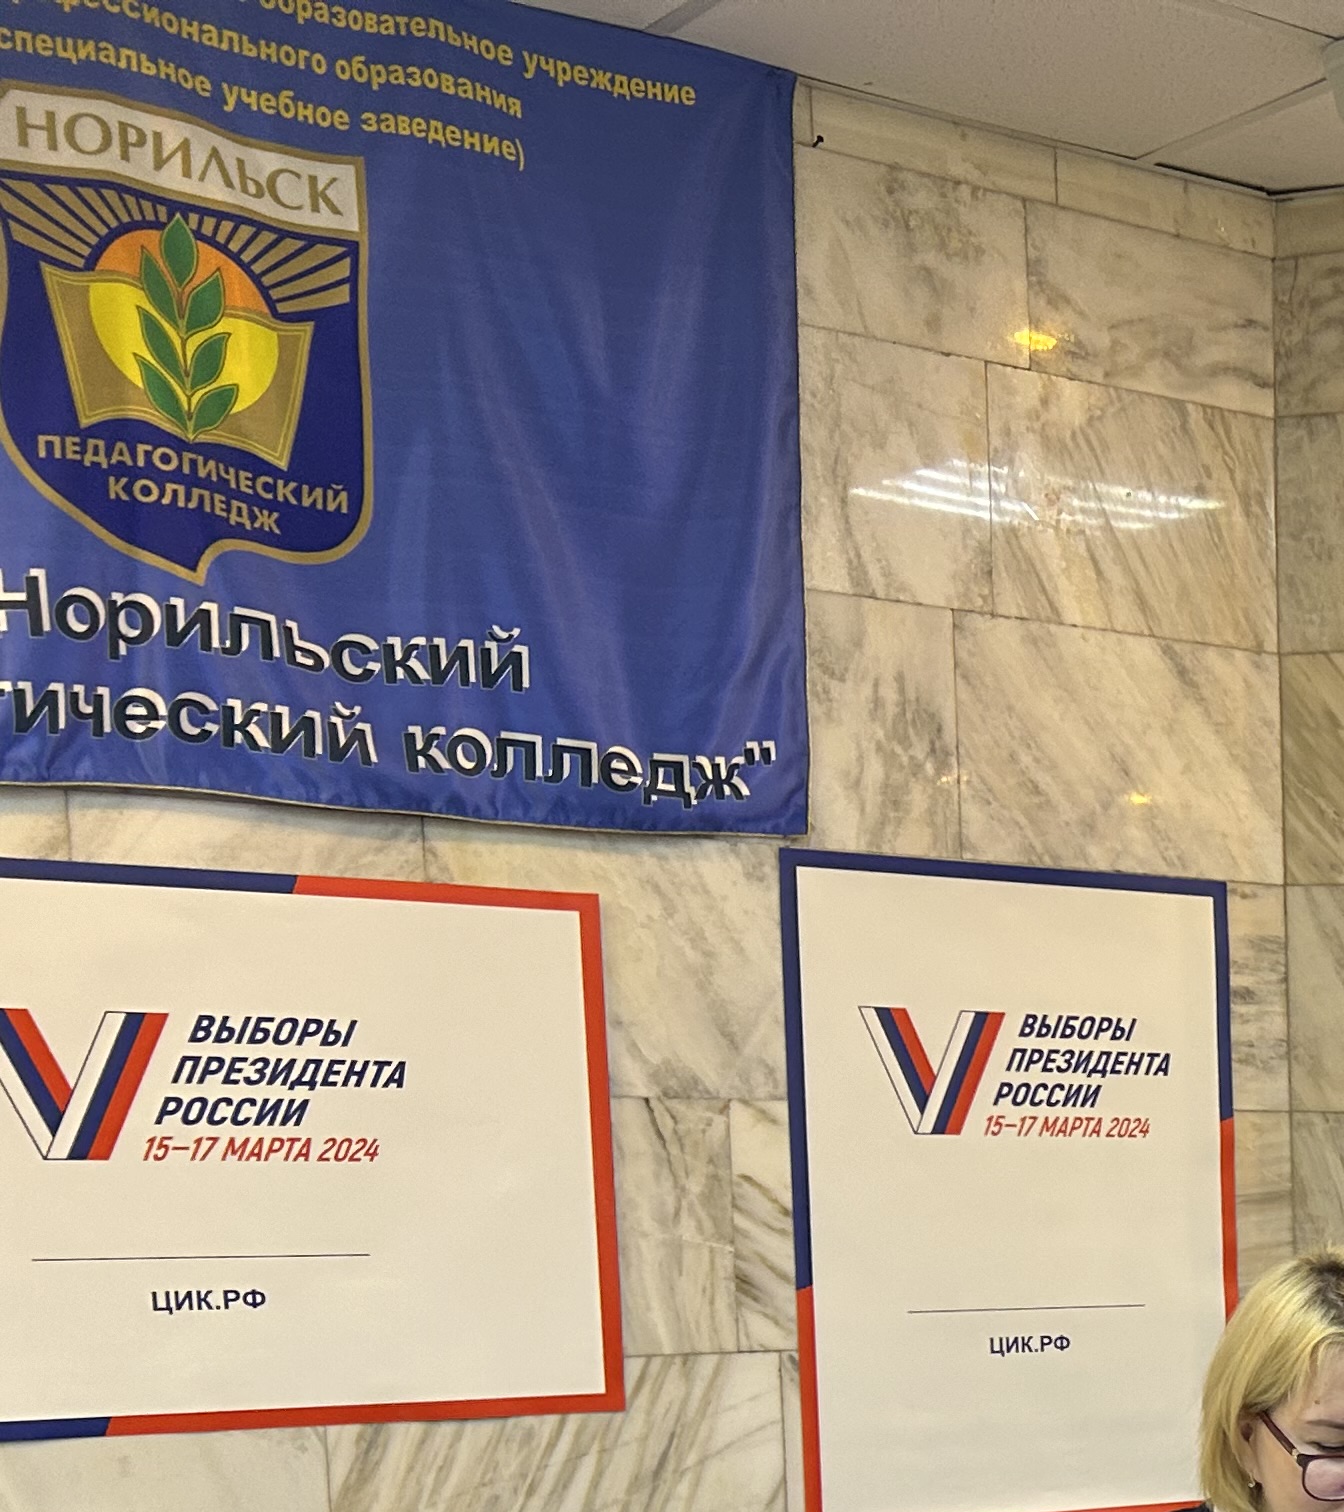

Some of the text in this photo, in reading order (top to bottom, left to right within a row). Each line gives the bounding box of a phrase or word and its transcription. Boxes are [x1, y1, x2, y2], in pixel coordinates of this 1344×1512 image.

[335, 55, 522, 118] образования
[522, 50, 697, 105] учреждение
[221, 81, 350, 131] учебное
[361, 110, 525, 172] заведение)
[15, 106, 344, 217] НОРИЛЬСК
[37, 434, 349, 514] ПЕДАГОГИЧЕСКИЙ
[108, 475, 281, 536] КОЛЛЕДЖ
[0, 681, 777, 810] ический колледж"
[188, 1014, 358, 1048] ВЫБОРЫ
[1018, 1014, 1137, 1042] ВЫБОРЫ
[171, 1056, 408, 1091] ПРЕЗИДЕНТА
[1005, 1047, 1172, 1078] ПРЕЗИДЕНТА
[154, 1096, 310, 1127] РОССИИ
[993, 1081, 1101, 1109] РОССИИ
[1039, 1116, 1102, 1138] МАРТА
[1106, 1117, 1150, 1139] 2024
[221, 1137, 312, 1162] МАРТА
[317, 1138, 380, 1163] 2024
[151, 1289, 267, 1315] ЦИК.РФ
[989, 1335, 1071, 1357] ЦИК.РФ
